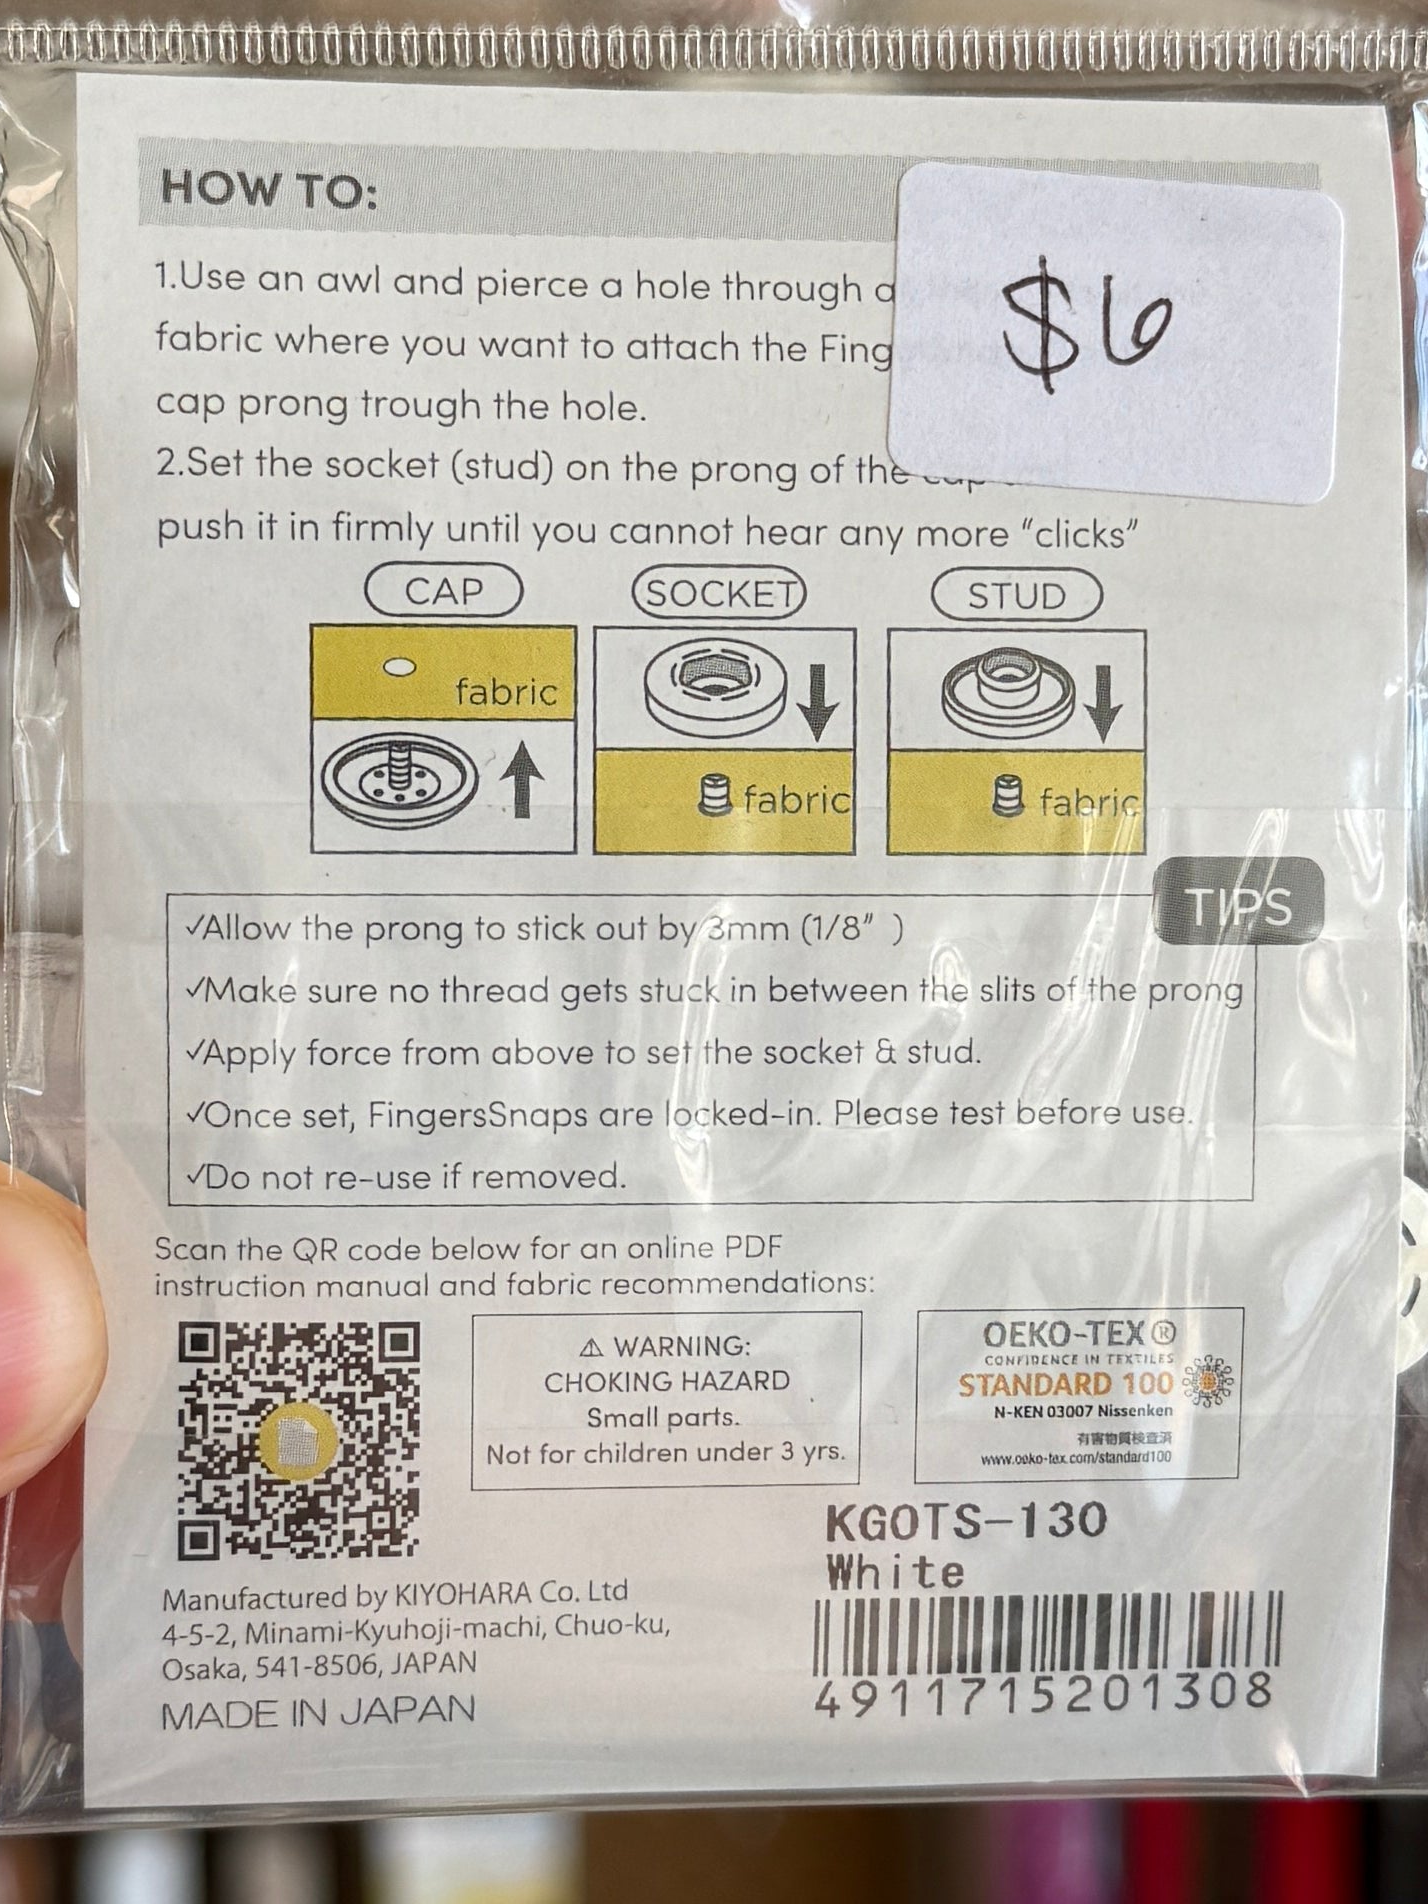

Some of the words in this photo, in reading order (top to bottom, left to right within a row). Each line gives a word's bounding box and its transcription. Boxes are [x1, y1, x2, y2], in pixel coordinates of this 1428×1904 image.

[161, 167, 283, 207] HOW
[295, 172, 377, 211] TO:
[154, 258, 247, 292] 1.Use
[257, 269, 304, 293] an
[316, 263, 381, 295] awl
[393, 264, 464, 297] and
[476, 267, 589, 306] pierce
[599, 277, 623, 300] a
[636, 267, 711, 301] hole
[721, 269, 863, 312] through
[1000, 253, 1174, 395] $6
[153, 319, 263, 354] fabric
[273, 322, 390, 356] where
[400, 334, 466, 366] you
[477, 330, 570, 360] want
[579, 331, 615, 360] to
[626, 329, 740, 362] attach
[750, 330, 808, 363] the
[821, 333, 892, 371] Fing
[155, 391, 226, 425] cap
[238, 393, 349, 427] prong
[360, 387, 481, 428] trough
[492, 388, 550, 421] the
[562, 388, 647, 422] hole.
[156, 445, 245, 478] 2.Set
[253, 445, 313, 478] the
[324, 446, 441, 480] socket
[450, 447, 554, 487] (stud)
[565, 459, 610, 482] on
[621, 449, 679, 483] the
[691, 459, 798, 493] prong
[809, 452, 847, 485] of
[856, 454, 909, 484] the
[157, 507, 244, 550] push
[257, 510, 279, 541] it
[289, 510, 320, 542] in
[331, 509, 435, 552] firmly
[446, 510, 520, 544] until
[531, 521, 597, 553] you
[608, 516, 734, 546] cannot
[745, 513, 829, 547] hear
[838, 524, 905, 557] any
[916, 525, 1010, 549] more
[404, 576, 484, 607] CAP
[644, 578, 800, 610] SOCKET
[968, 574, 1067, 611] STUD
[455, 672, 562, 711] fabric
[742, 778, 854, 817] fabric
[1038, 783, 1140, 821] fabric
[1184, 887, 1293, 926] TIPS
[200, 911, 293, 942] Allow
[300, 912, 354, 942] the
[364, 920, 464, 950] prong
[473, 914, 506, 942] to
[516, 911, 587, 942] stick
[595, 914, 649, 942] out
[658, 912, 698, 949] by
[706, 915, 791, 943] 3mm
[203, 974, 298, 1004] Make
[307, 983, 378, 1007] sure
[389, 983, 430, 1005] no
[438, 973, 549, 1004] thread
[560, 976, 629, 1012] gets
[638, 974, 722, 1006] stuck
[730, 975, 757, 1004] in
[768, 973, 910, 1004] between
[918, 972, 969, 1004] the
[979, 973, 1036, 1003] slits
[1046, 973, 1081, 1004] of
[1086, 972, 1138, 1004] the
[1148, 978, 1244, 1011] prong
[201, 1037, 297, 1075] Apply
[305, 1037, 392, 1067] force
[400, 1036, 480, 1067] from
[491, 1036, 595, 1067] above
[603, 1039, 639, 1066] to
[646, 1037, 695, 1067] set
[703, 1036, 755, 1067] the
[763, 1035, 868, 1066] socket
[875, 1037, 899, 1065] &
[907, 1035, 983, 1067] stud.
[203, 1099, 293, 1129] Once
[299, 1101, 356, 1135] set,
[369, 1100, 589, 1136] FingersSnaps
[598, 1106, 654, 1128] are
[665, 1096, 823, 1129] locked-in.
[834, 1091, 939, 1128] Please
[947, 1099, 1007, 1127] test
[1016, 1091, 1122, 1126] before
[1132, 1101, 1195, 1128] use.
[206, 1162, 251, 1191] Do
[261, 1164, 315, 1193] not
[324, 1169, 432, 1193] re-use
[441, 1160, 468, 1190] if
[470, 1159, 627, 1190] removed.
[154, 1235, 227, 1264] Scan
[235, 1237, 287, 1263] the
[291, 1236, 339, 1265] QR
[348, 1236, 421, 1262] code
[431, 1235, 522, 1262] below
[529, 1234, 573, 1261] for
[579, 1240, 618, 1261] an
[627, 1234, 715, 1261] online
[725, 1233, 784, 1259] PDF
[154, 1271, 306, 1300] instruction
[316, 1267, 429, 1299] manual
[438, 1266, 497, 1297] and
[507, 1269, 592, 1298] fabric
[600, 1268, 876, 1297] recommendations:
[613, 1333, 754, 1361] WARNING:
[1085, 1354, 1099, 1366] IN
[1107, 1353, 1174, 1365] TEXTILES
[543, 1369, 674, 1395] CHOKING
[681, 1368, 791, 1393] HAZARD
[959, 1373, 1112, 1398] STANDARD
[1123, 1372, 1173, 1396] 100
[586, 1400, 659, 1429] Small
[667, 1405, 742, 1436] parts.
[994, 1405, 1044, 1419] N-KEN
[1047, 1404, 1093, 1419] 03007
[1098, 1404, 1173, 1418] Nissenken
[486, 1442, 533, 1466] Not
[538, 1441, 578, 1465] for
[583, 1439, 688, 1465] children
[696, 1439, 775, 1464] under
[780, 1440, 795, 1462] 3
[801, 1444, 847, 1468] yrs.
[825, 1499, 1109, 1544] KGOTS-130
[825, 1551, 965, 1594] White
[162, 1583, 348, 1614] Manufactured
[355, 1582, 389, 1615] by
[393, 1580, 533, 1609] KIYOHARA
[538, 1579, 581, 1604] Co.
[586, 1576, 629, 1603] Ltd
[160, 1622, 238, 1651] 4-5-2,
[244, 1614, 548, 1650] Minami-Kyuhoji-machi,
[554, 1610, 671, 1638] Chuo-ku,
[161, 1655, 248, 1684] Osaka,
[254, 1651, 384, 1681] 541-8506,
[390, 1649, 477, 1676] JAPAN
[161, 1699, 280, 1732] MADE
[291, 1697, 328, 1728] IN
[338, 1693, 476, 1726] JAPAN
[814, 1669, 1273, 1720] 4911715201308
